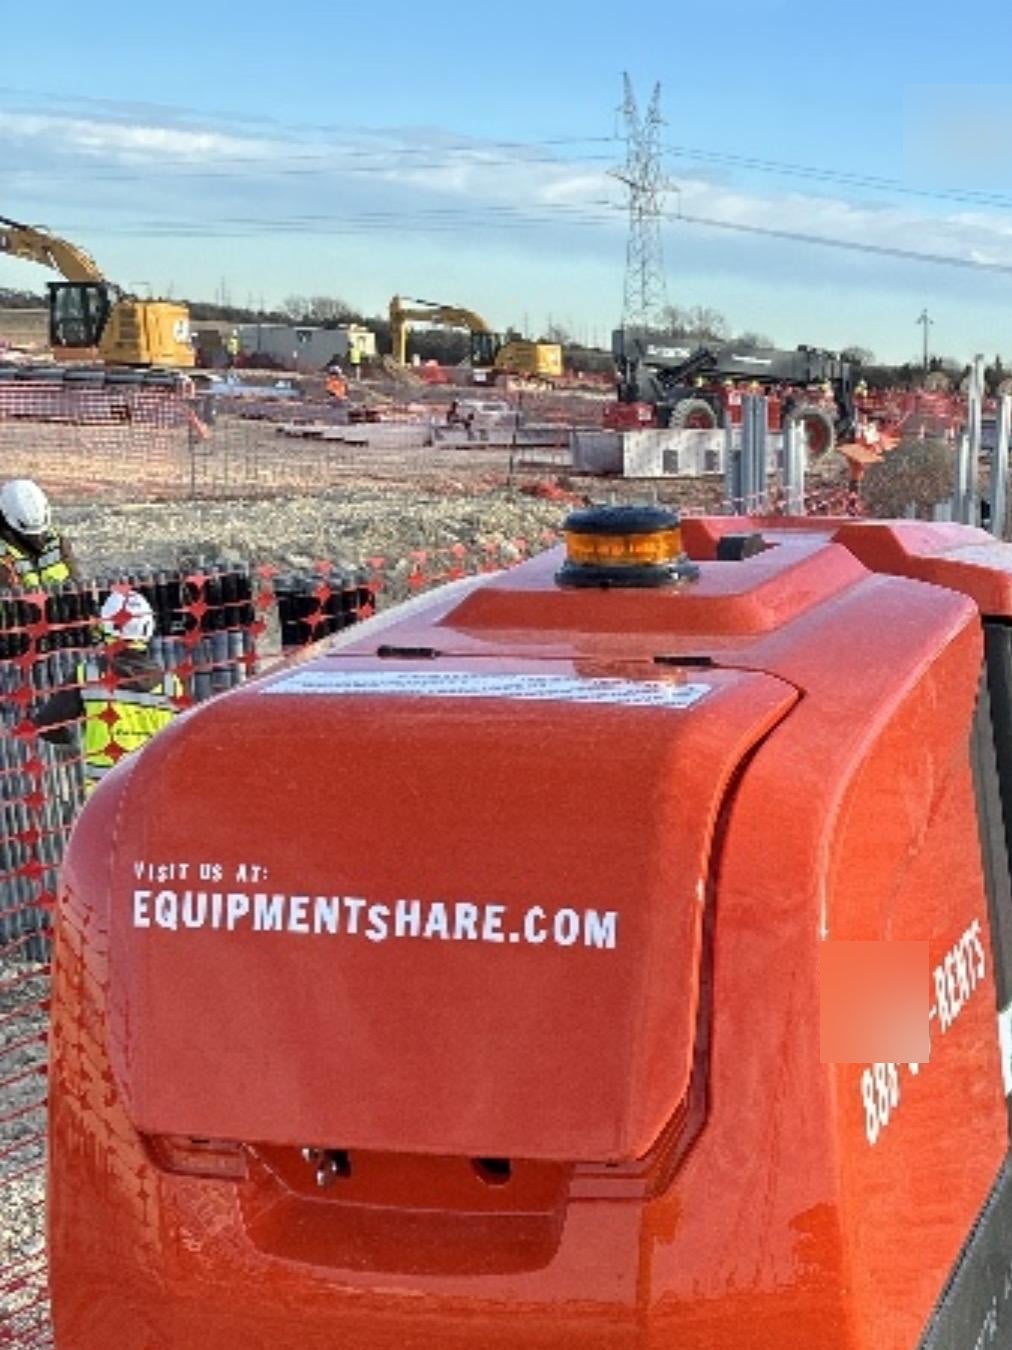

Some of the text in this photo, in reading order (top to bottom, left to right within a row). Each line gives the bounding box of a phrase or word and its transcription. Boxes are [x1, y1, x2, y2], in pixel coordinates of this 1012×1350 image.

[200, 863, 222, 882] US
[236, 863, 268, 882] AT:
[133, 890, 617, 948] EQUIPMENTSHARE.COM
